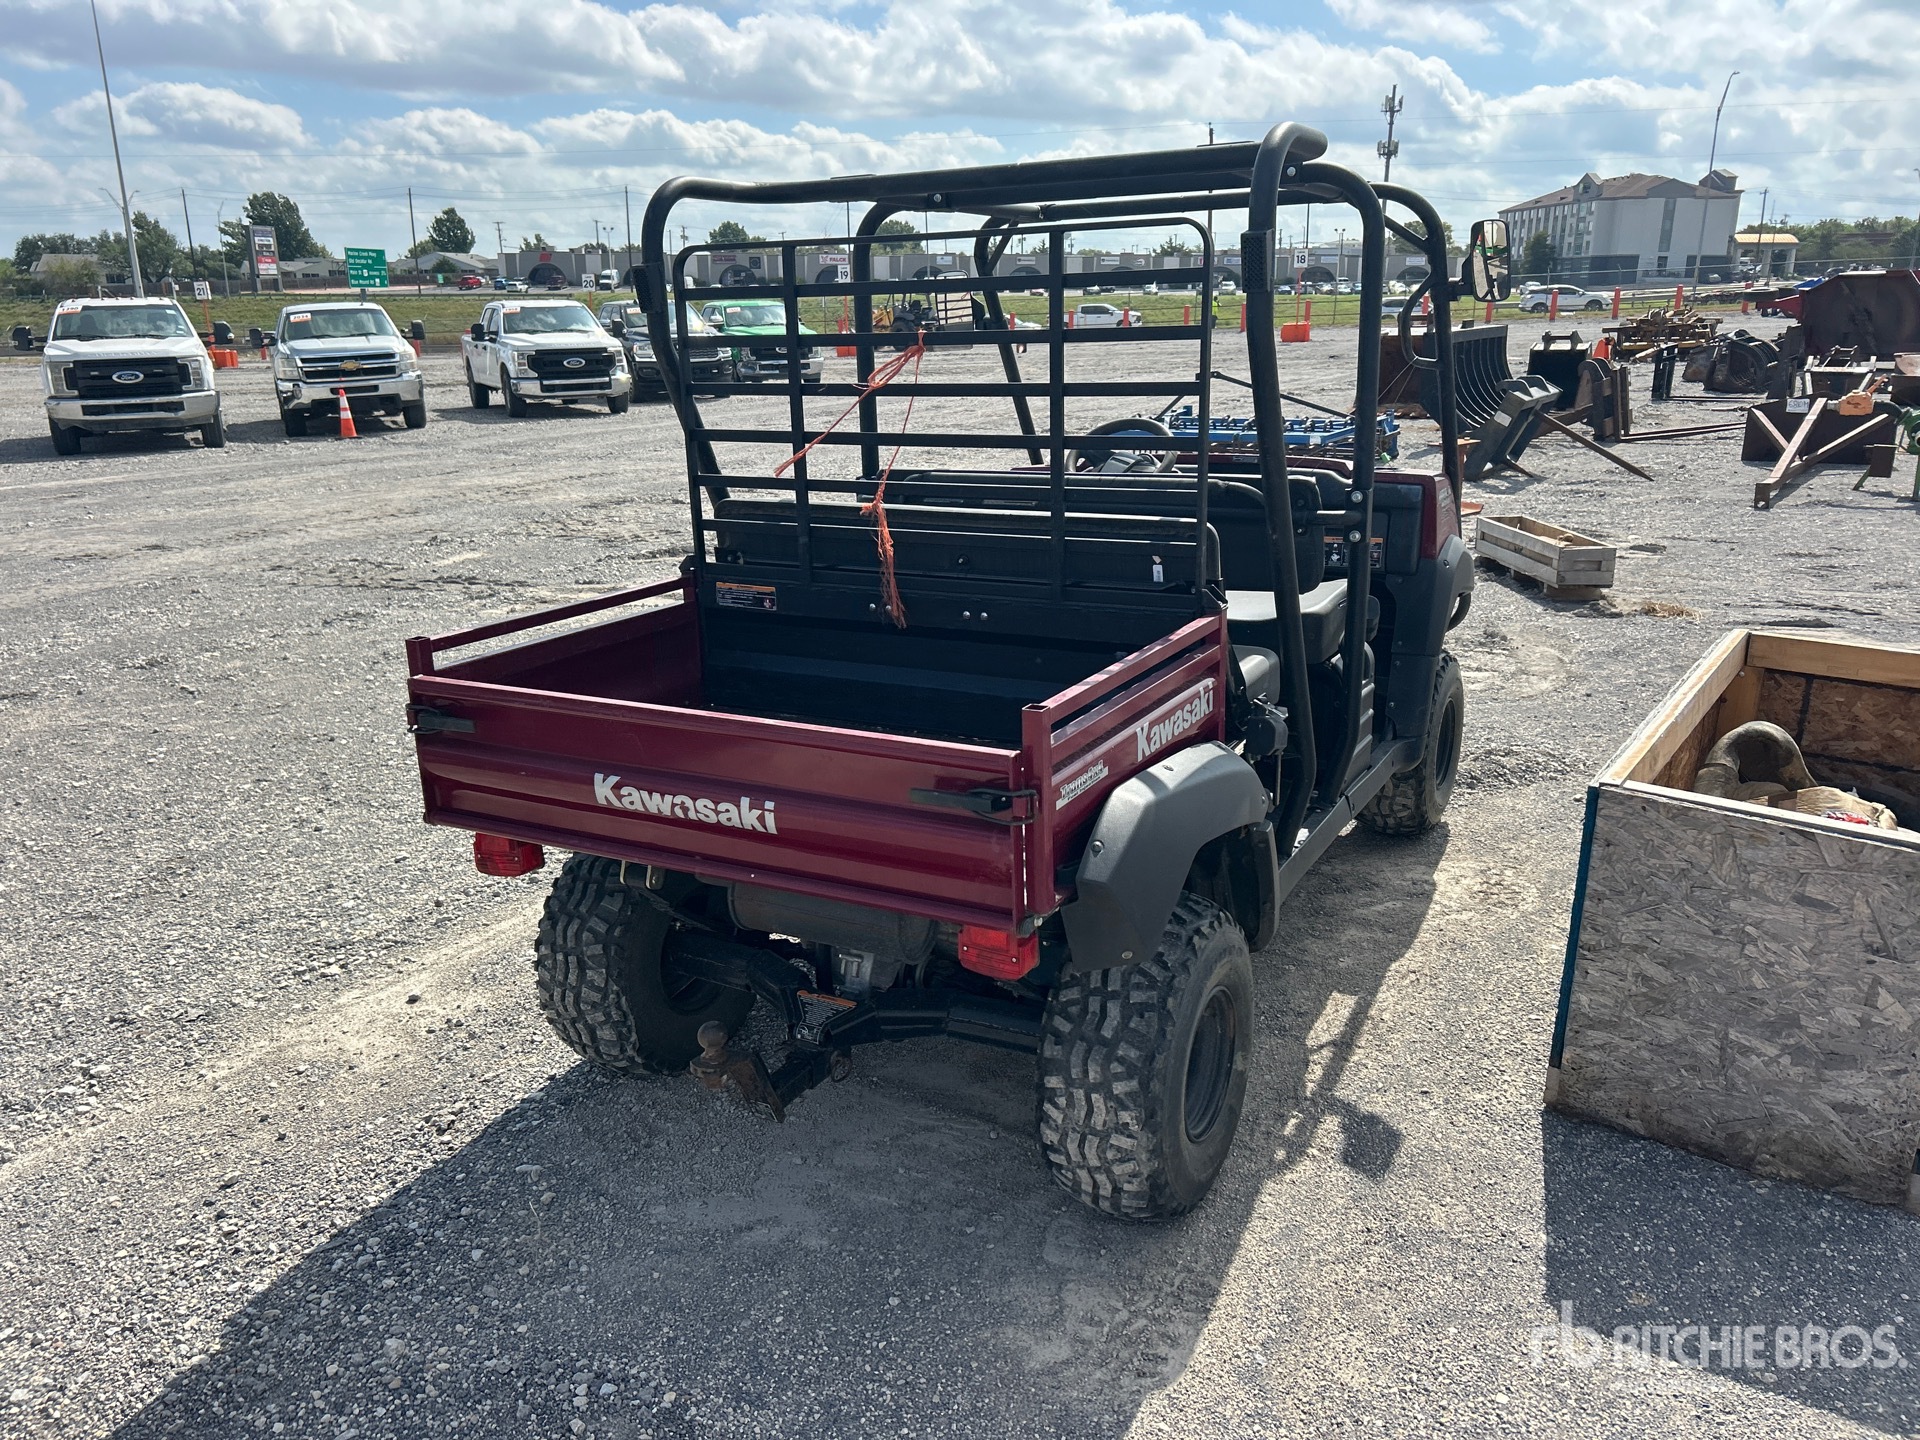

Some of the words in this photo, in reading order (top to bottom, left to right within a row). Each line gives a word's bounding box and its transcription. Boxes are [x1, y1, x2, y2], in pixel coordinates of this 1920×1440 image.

[1296, 255, 1306, 264] 18
[840, 270, 849, 280] 19
[583, 279, 595, 289] 20
[196, 287, 206, 296] 21
[120, 373, 136, 381] Ford
[1136, 681, 1214, 762] Kawasaki
[593, 772, 778, 835] Kawasaki
